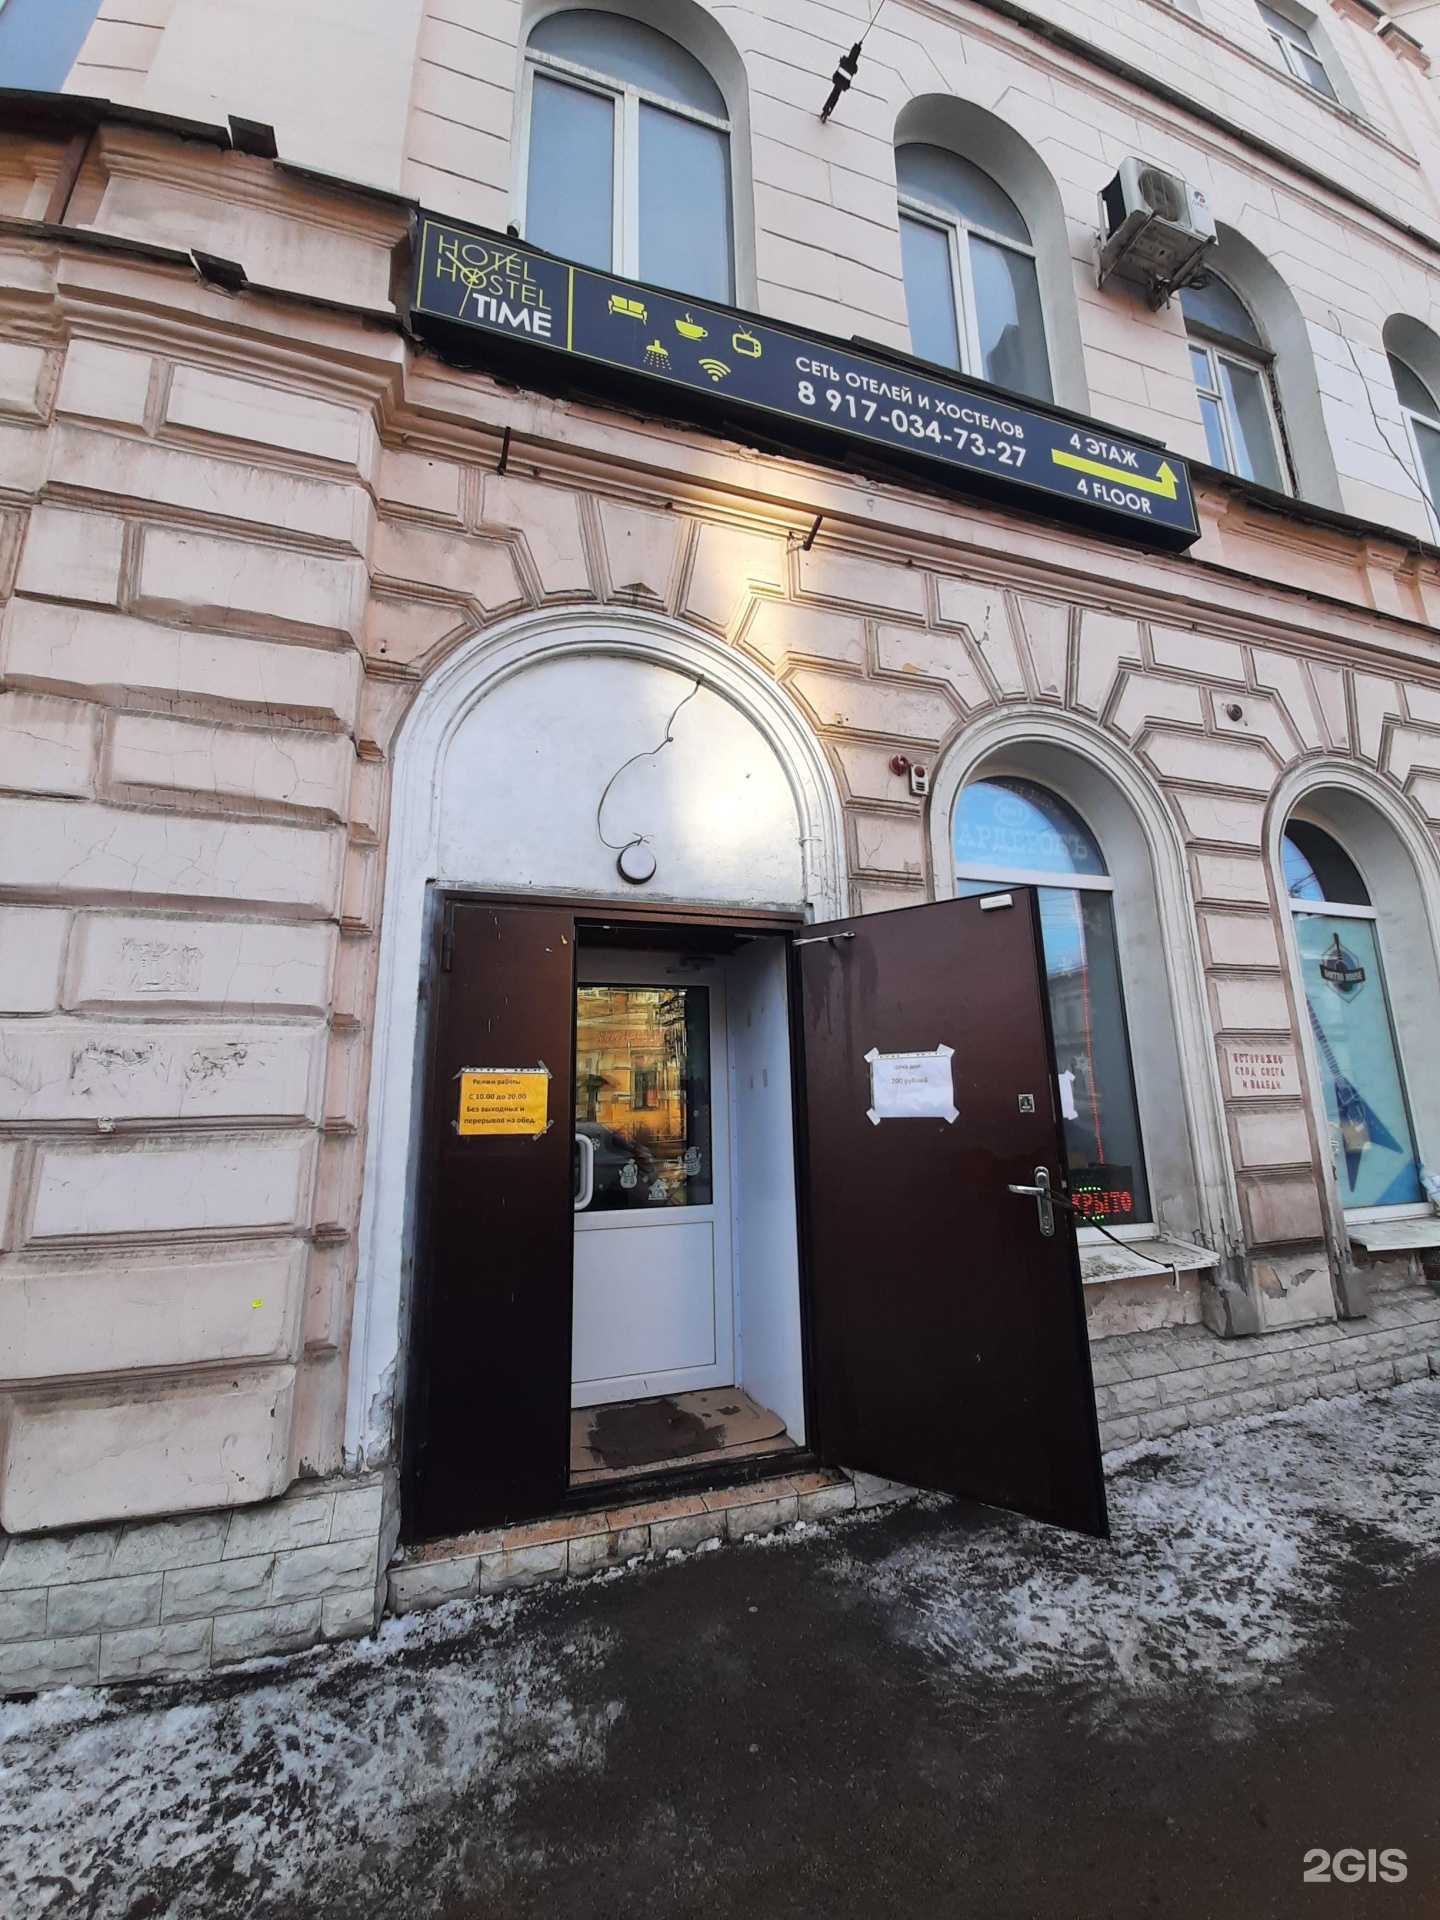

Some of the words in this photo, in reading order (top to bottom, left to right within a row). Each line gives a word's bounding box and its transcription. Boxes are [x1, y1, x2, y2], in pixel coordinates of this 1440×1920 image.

[439, 234, 536, 282] HOTEL
[437, 258, 551, 311] HOSTEL
[472, 293, 552, 338] TIME
[795, 356, 840, 382] СЕТЬ
[845, 371, 913, 404] ОТЕЛЕЙ
[917, 394, 930, 410] И
[935, 399, 1025, 439] ХОСТЕЛОВ
[797, 381, 816, 406] 8
[825, 389, 1027, 468] 917-034-73-27
[1069, 433, 1081, 450] 4
[1085, 437, 1139, 469] ЭТАЖ
[1076, 478, 1088, 496] 4
[1092, 482, 1153, 515] FLOOR
[1232, 1053, 1284, 1065] ОСТОРОЖНО
[1260, 1067, 1285, 1077] СНЕГА
